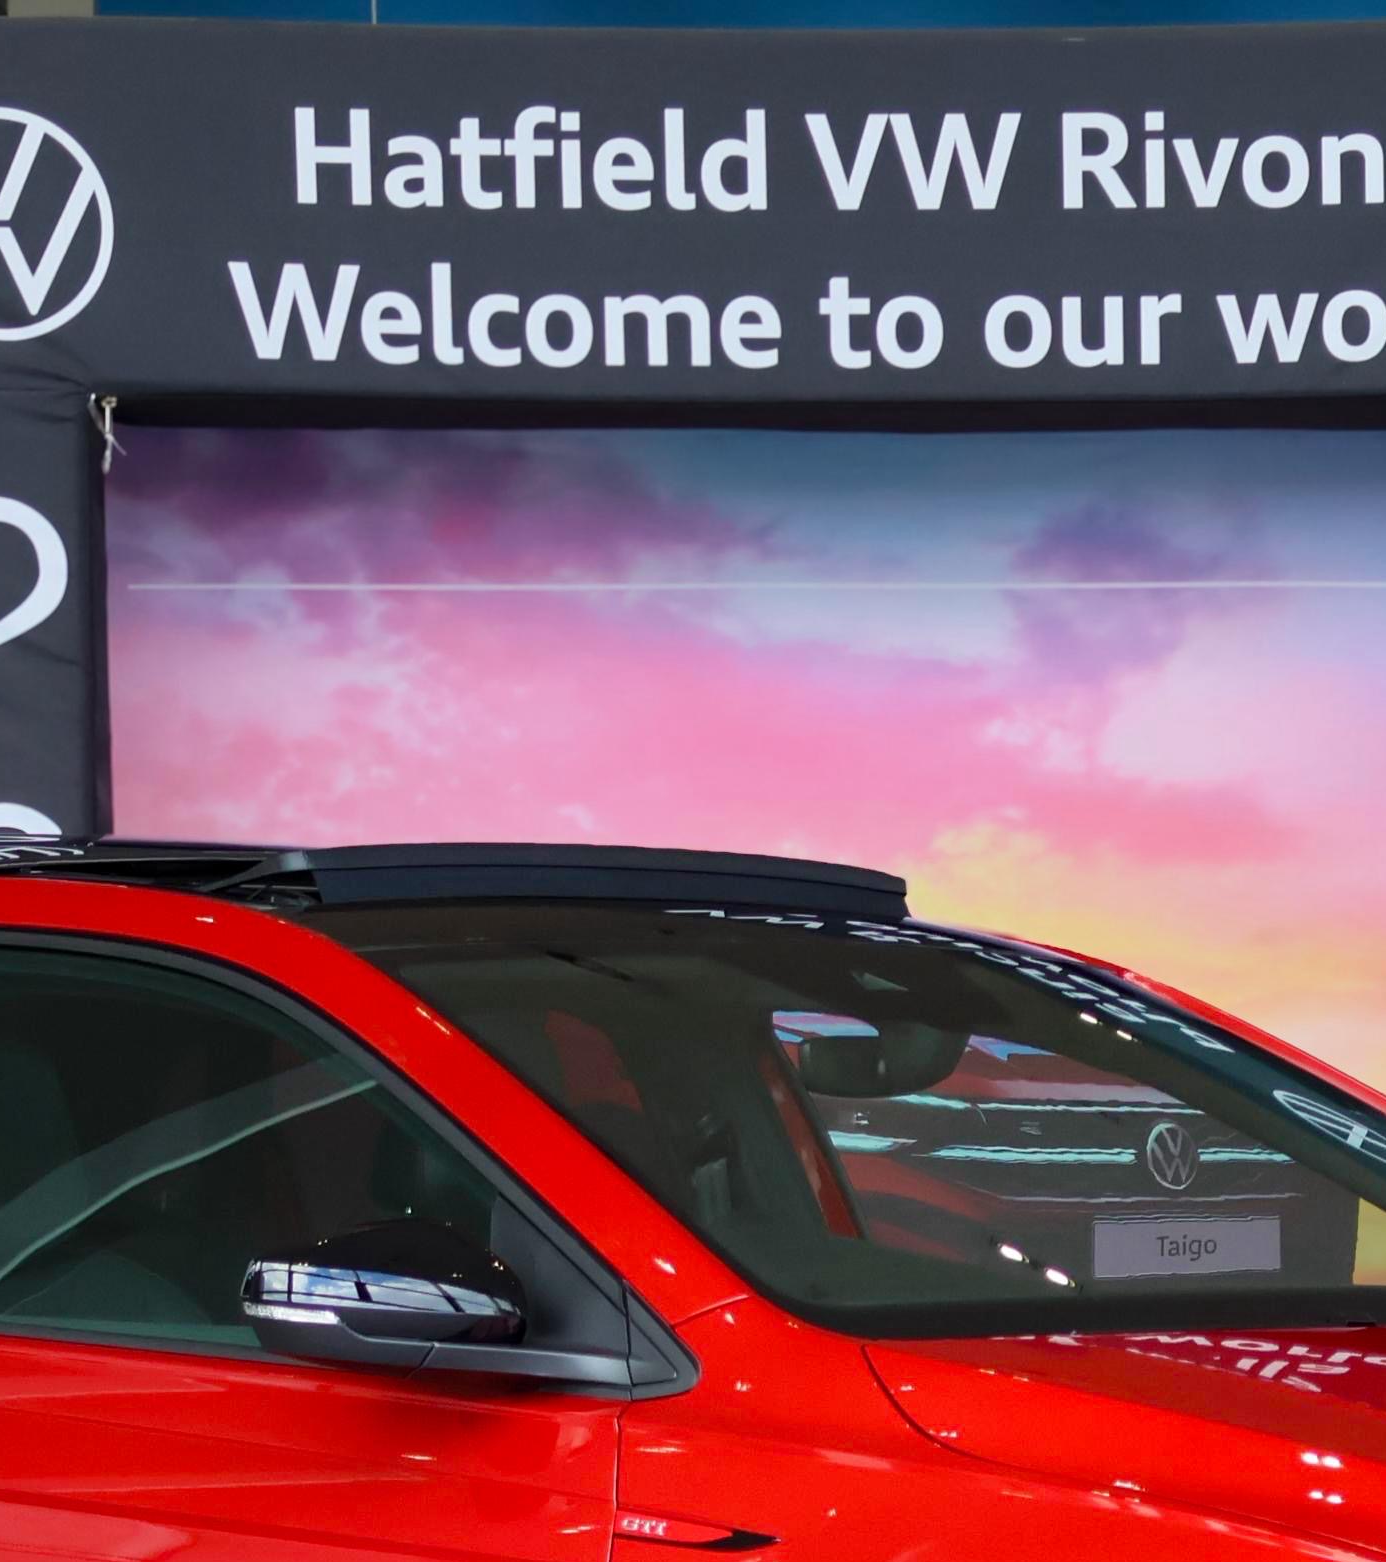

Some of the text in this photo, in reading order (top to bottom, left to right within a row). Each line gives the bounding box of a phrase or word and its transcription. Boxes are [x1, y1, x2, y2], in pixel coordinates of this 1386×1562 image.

[294, 105, 768, 213] Hatfield
[804, 112, 1022, 211] VW
[227, 260, 782, 369] Welcome
[818, 276, 944, 370] to
[984, 293, 1182, 369] our
[1156, 1234, 1218, 1262] Taigo
[621, 1516, 668, 1536] GTI
